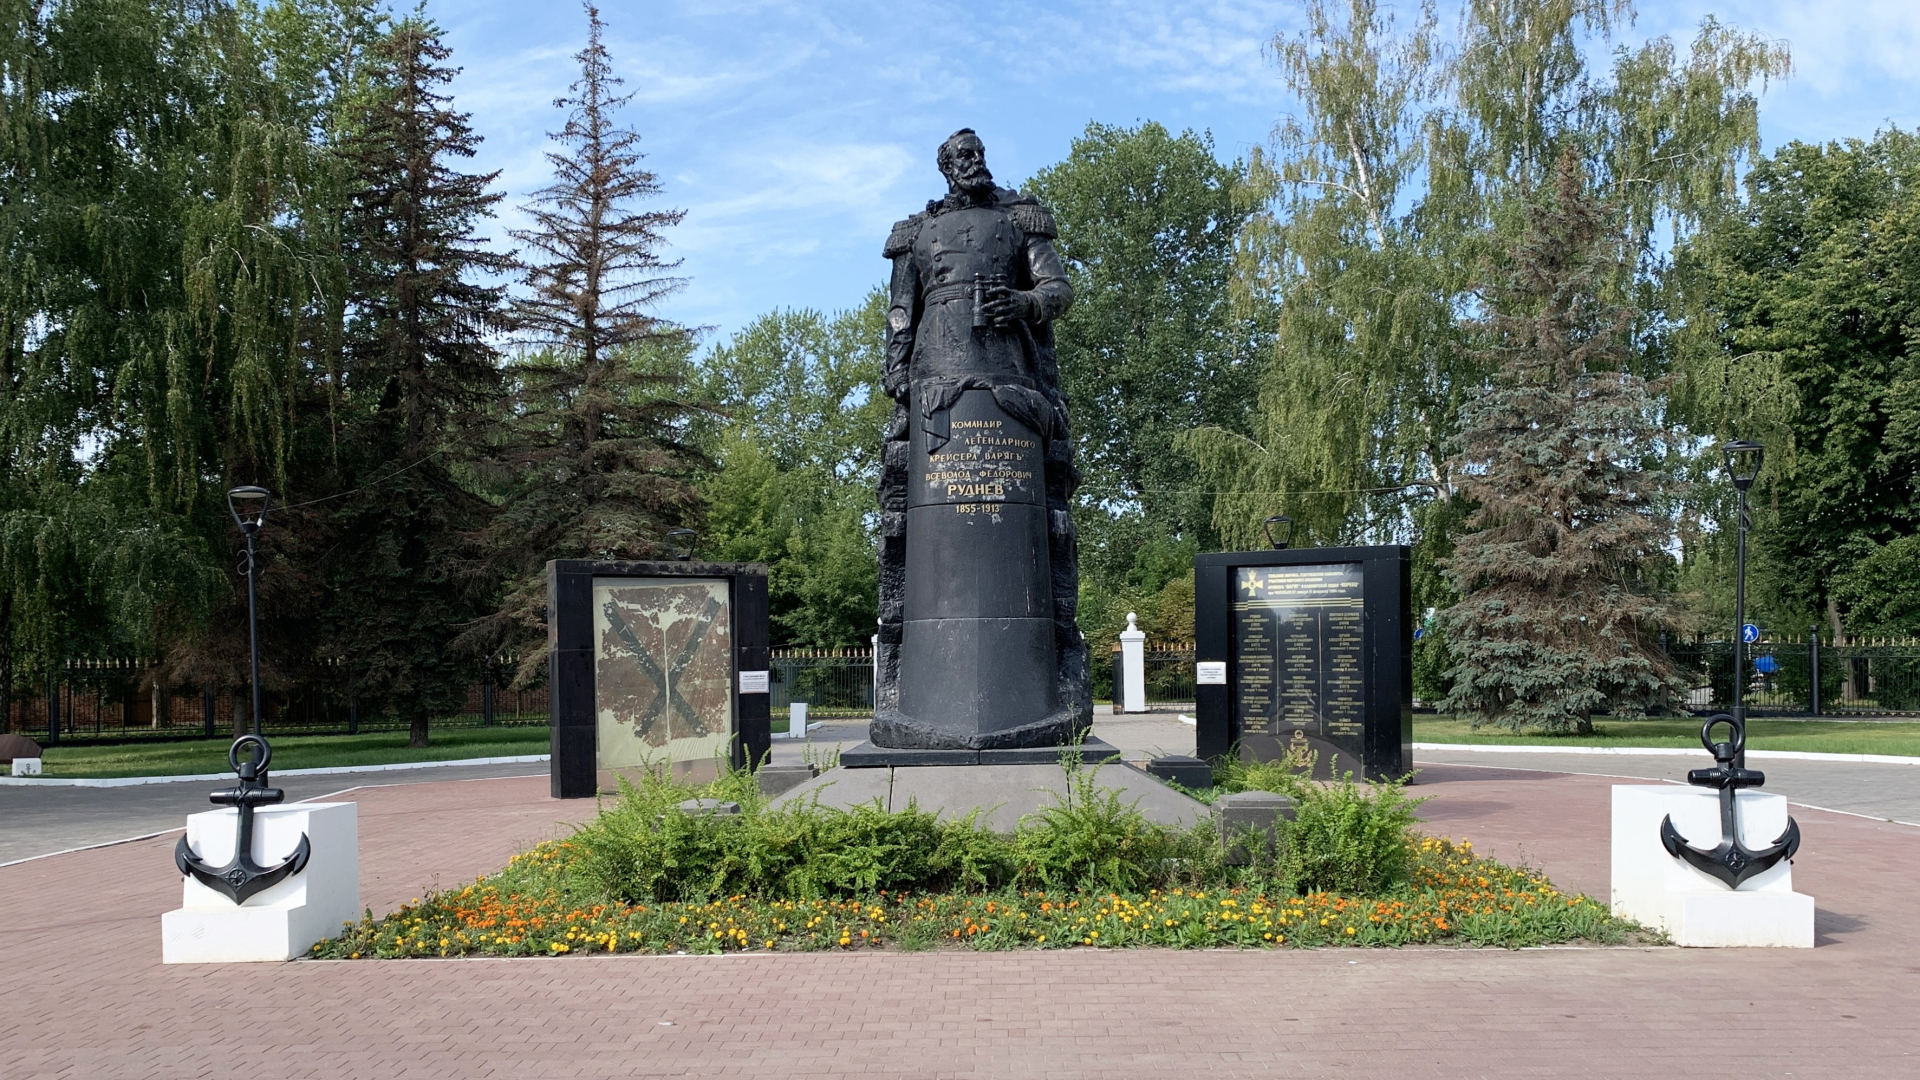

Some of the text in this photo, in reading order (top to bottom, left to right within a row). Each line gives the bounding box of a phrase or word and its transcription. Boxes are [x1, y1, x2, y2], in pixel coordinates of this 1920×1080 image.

[951, 420, 1003, 430] КОМАНДИР
[964, 436, 1036, 449] ЛЕГЕНДАРНОГО
[929, 451, 977, 463] КРЕЙСЕРА
[925, 470, 1032, 481] ВСЕВОЛОД ФЕДОРОВИЧ
[947, 484, 1005, 496] РУДНЕВ
[955, 504, 1001, 513] 1855-1913
